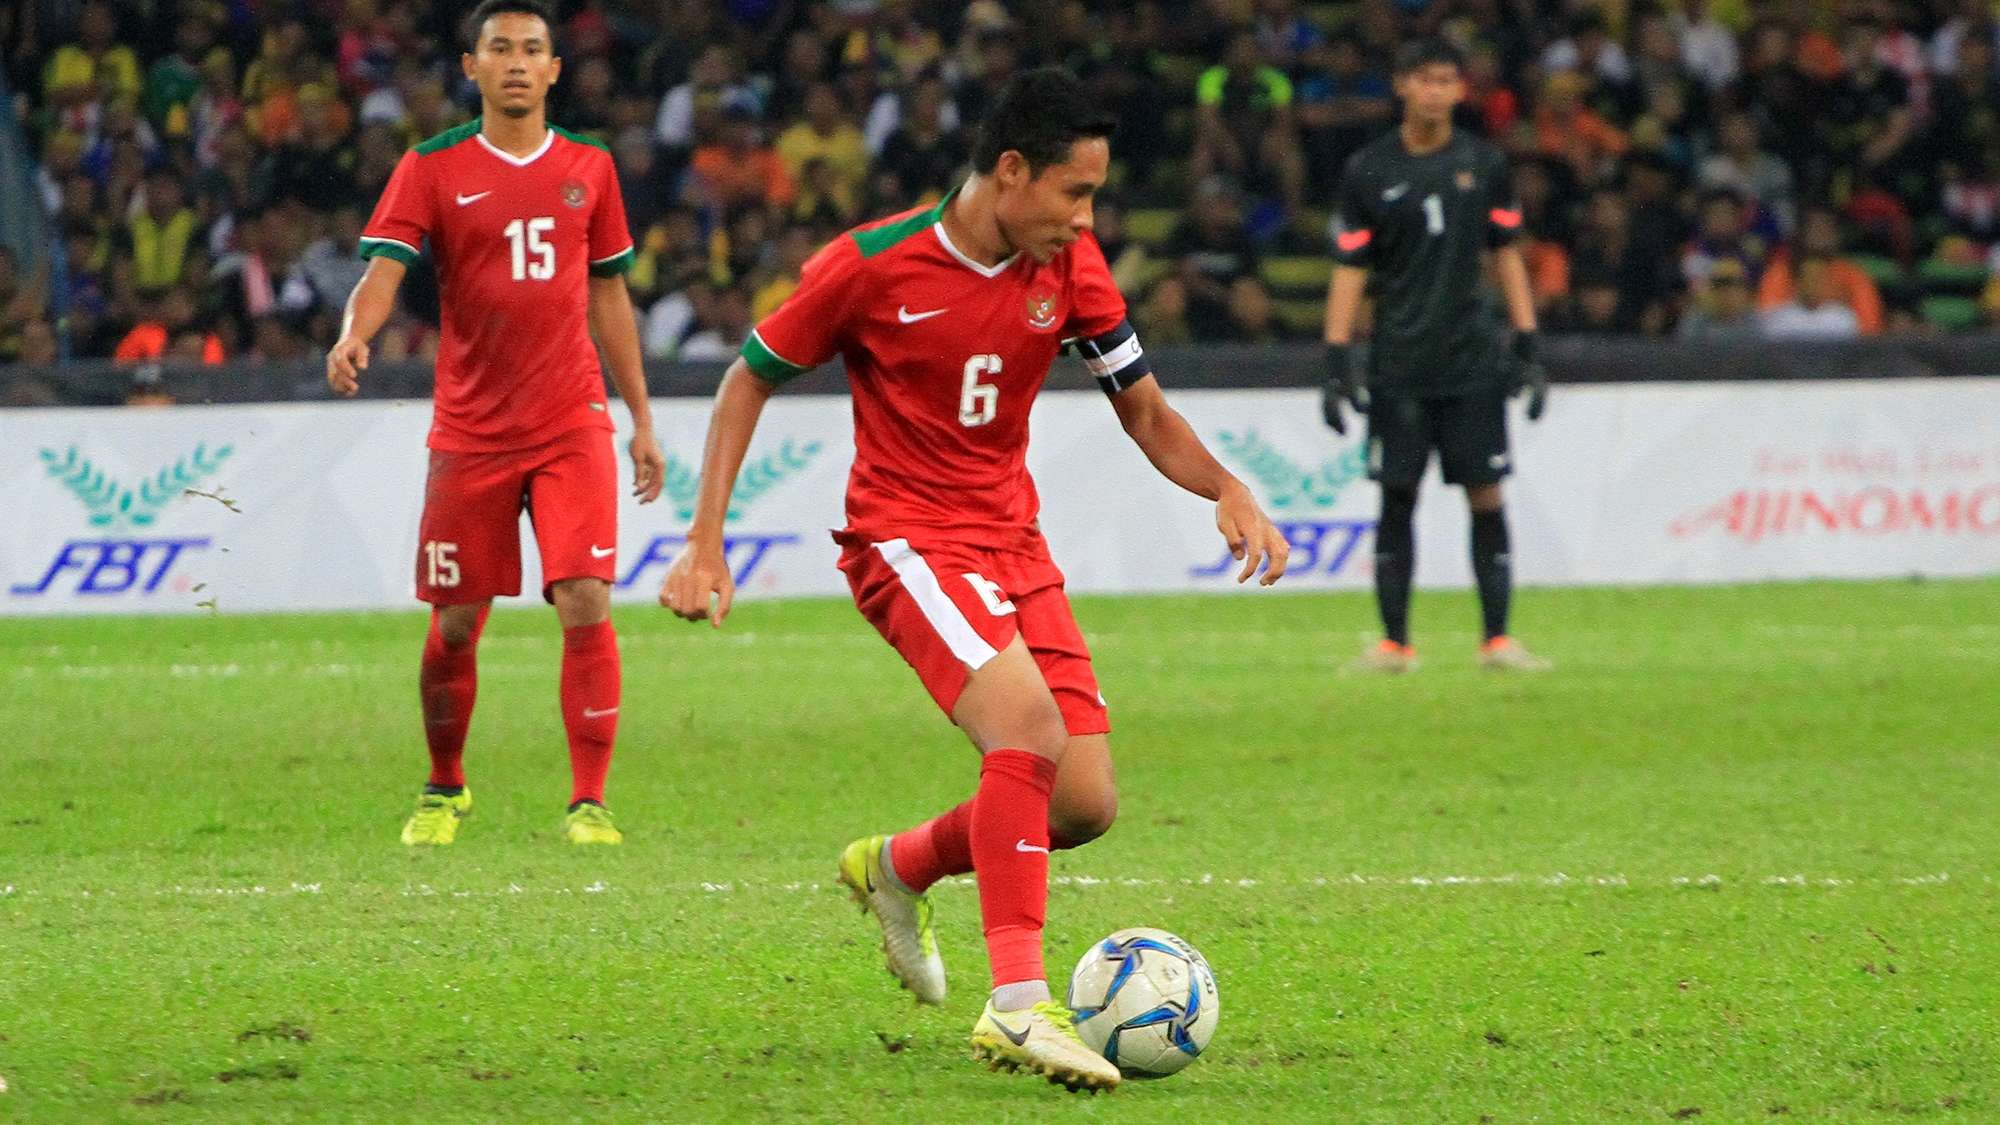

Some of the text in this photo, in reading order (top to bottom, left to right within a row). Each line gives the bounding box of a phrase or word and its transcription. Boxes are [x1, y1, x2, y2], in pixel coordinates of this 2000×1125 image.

[1422, 193, 1445, 236] 1
[503, 216, 556, 281] 15
[958, 354, 1003, 427] 6
[9, 535, 211, 594] FBT
[424, 540, 461, 588] 15
[615, 533, 804, 589] FT
